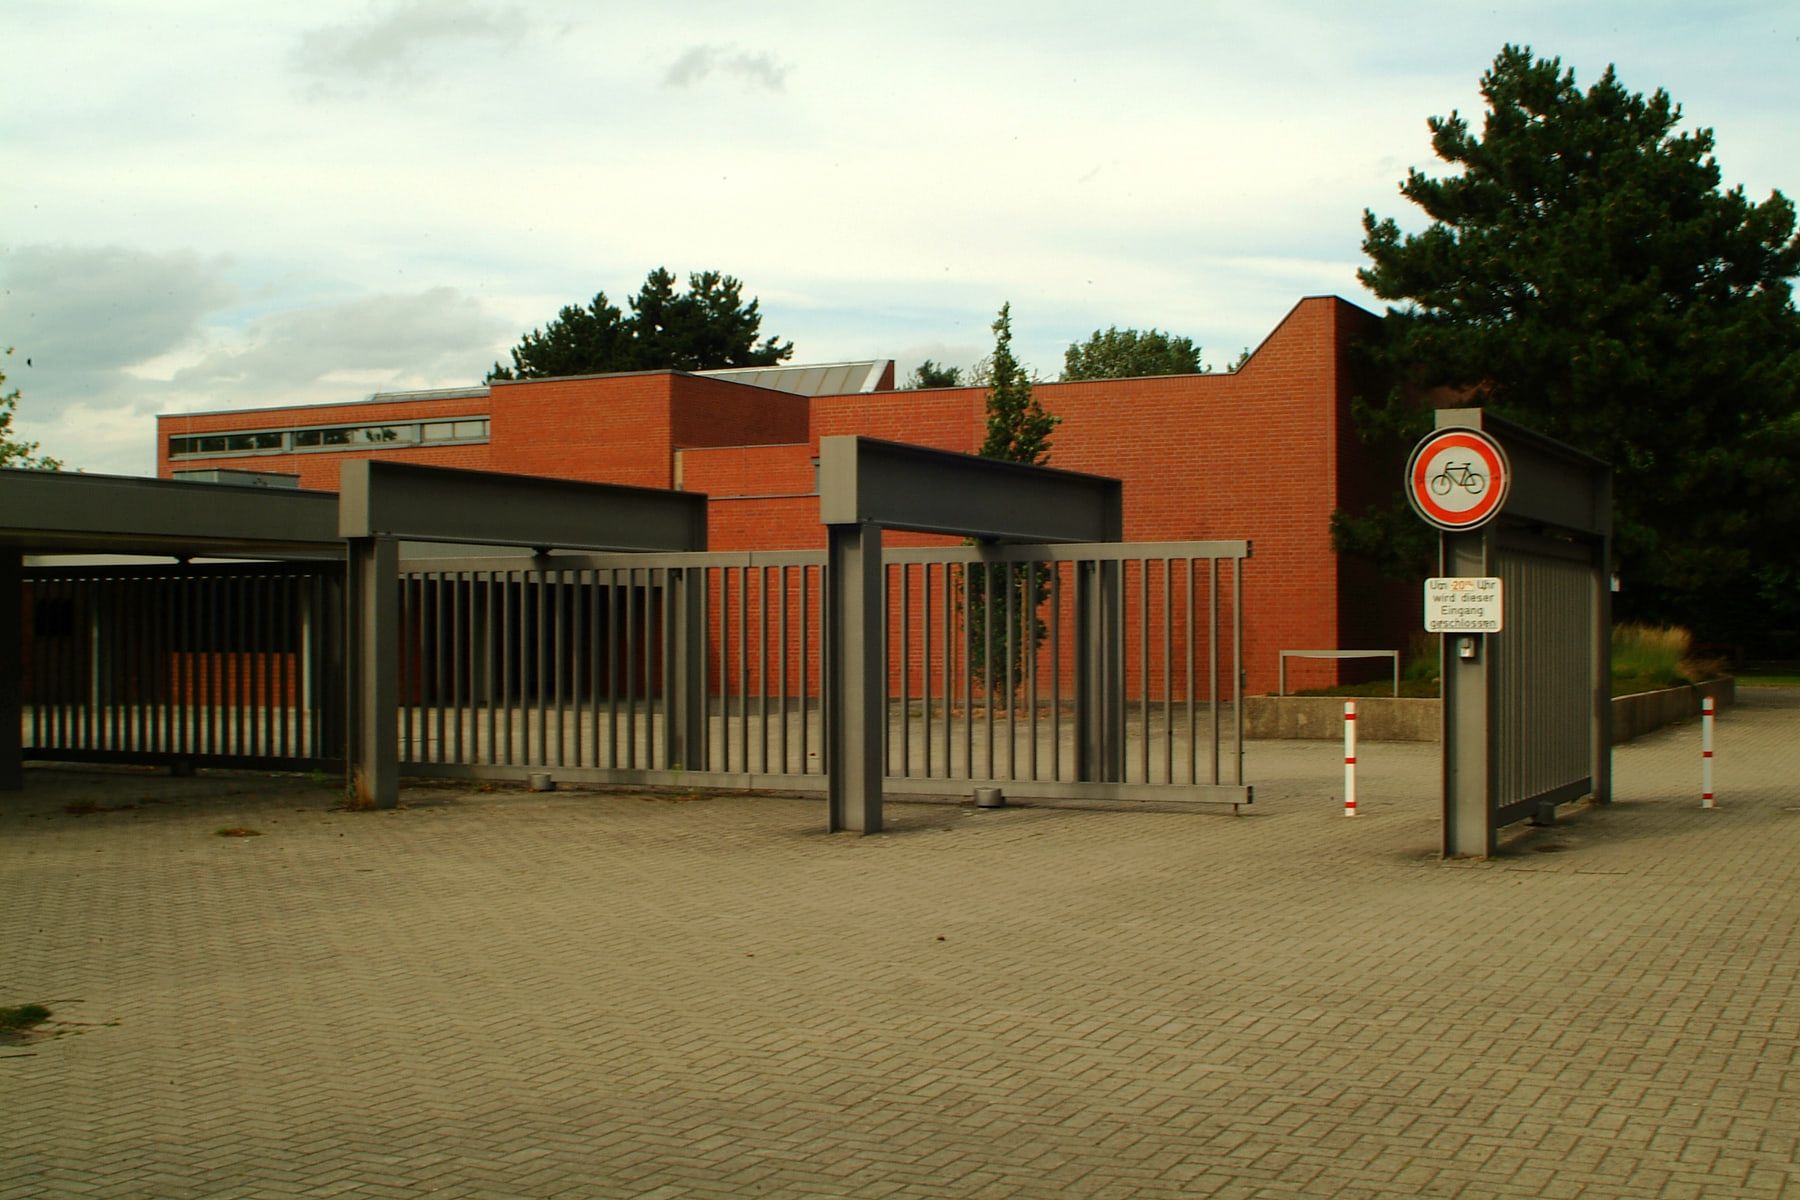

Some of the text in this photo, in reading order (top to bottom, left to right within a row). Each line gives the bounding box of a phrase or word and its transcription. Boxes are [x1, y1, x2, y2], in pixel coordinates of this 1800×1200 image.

[1430, 580, 1448, 590] Um
[1477, 580, 1496, 590] Uhr
[1432, 593, 1495, 602] wird dieser
[1441, 605, 1484, 617] Eingang
[1430, 618, 1496, 630] geschlossen
